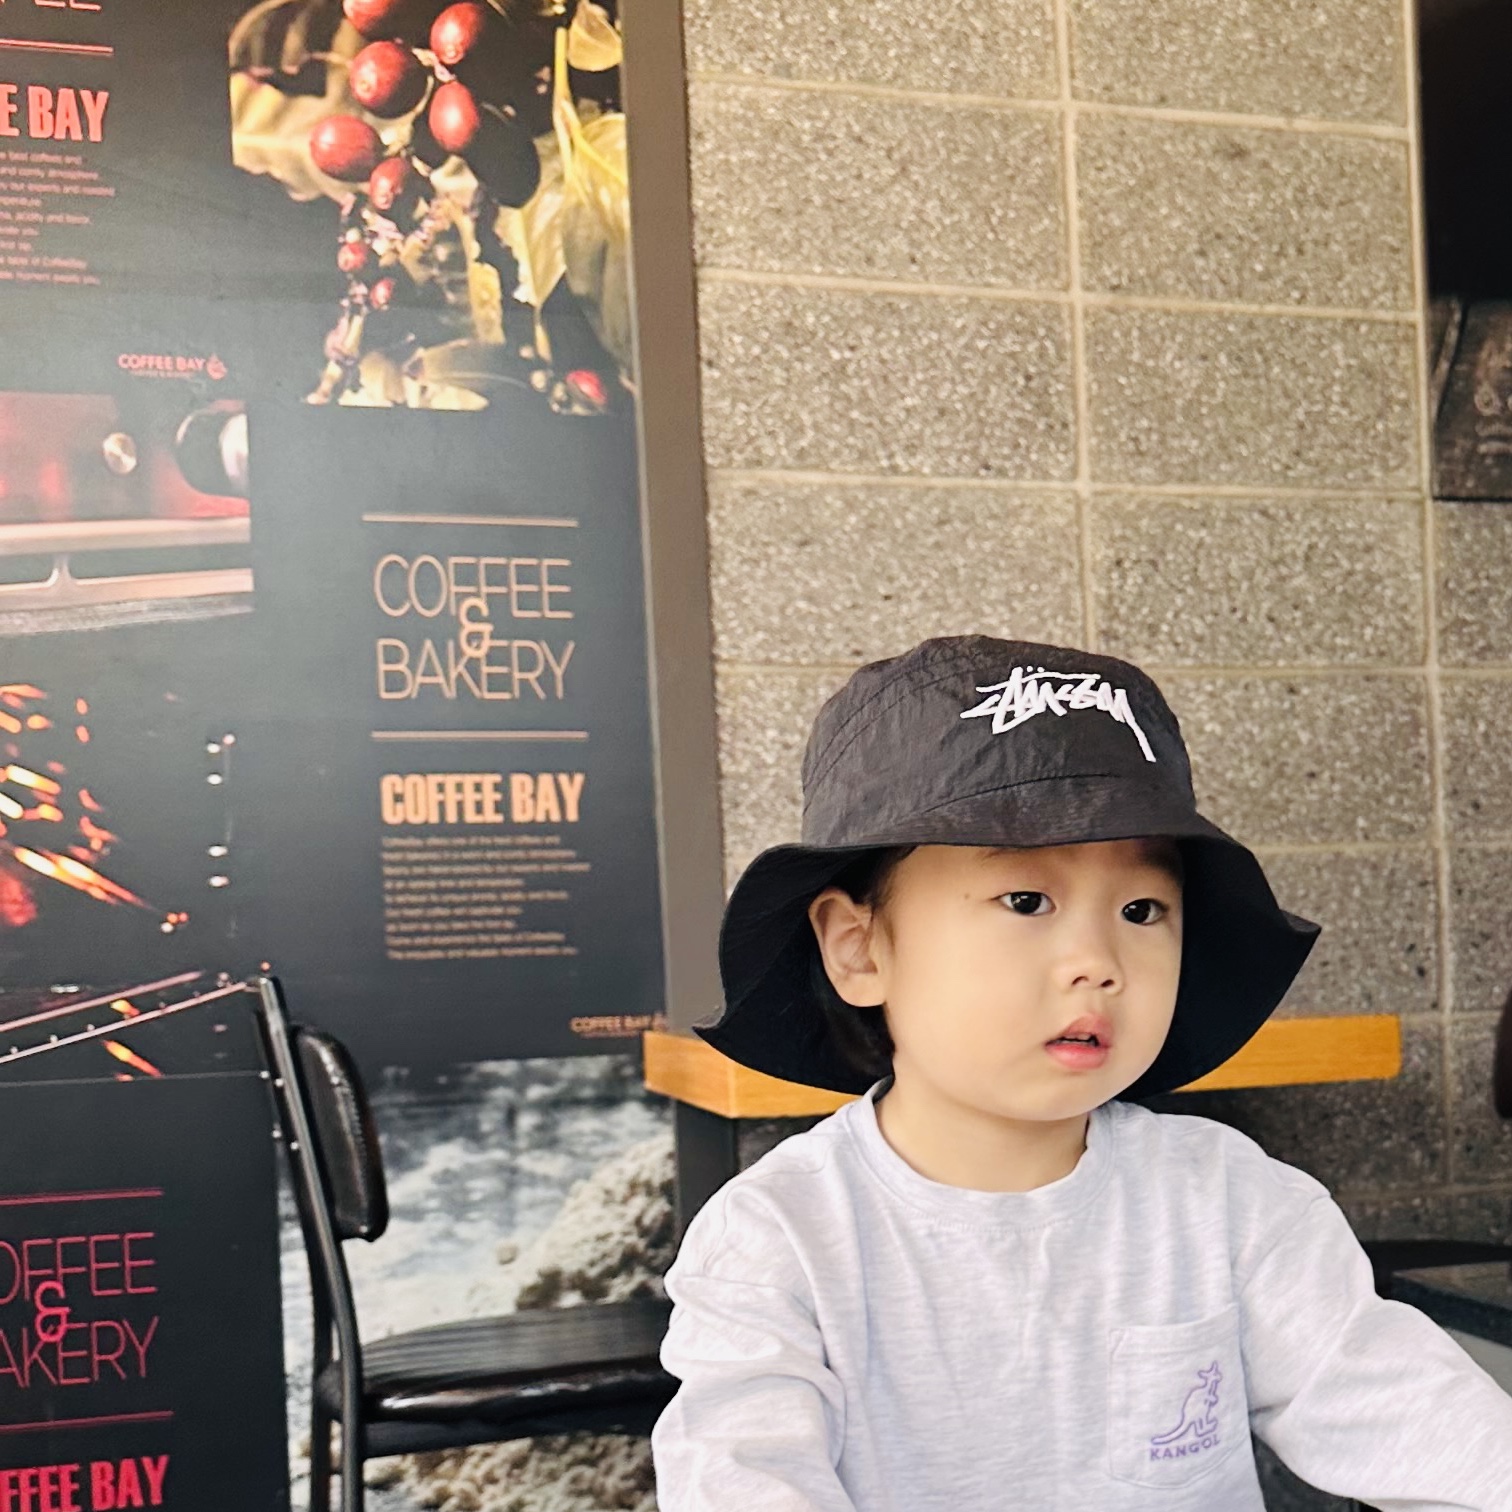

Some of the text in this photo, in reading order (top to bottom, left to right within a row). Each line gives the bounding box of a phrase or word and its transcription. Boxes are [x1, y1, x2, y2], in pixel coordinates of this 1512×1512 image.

[27, 85, 109, 142] BAY
[118, 354, 174, 371] COFFEE
[373, 554, 575, 619] COFFEE
[458, 597, 494, 659] &
[376, 637, 576, 700] BAKERY
[380, 772, 585, 824] COFFEE BAY
[1150, 1434, 1221, 1461] KANGOL
[89, 1454, 170, 1512] BAY
